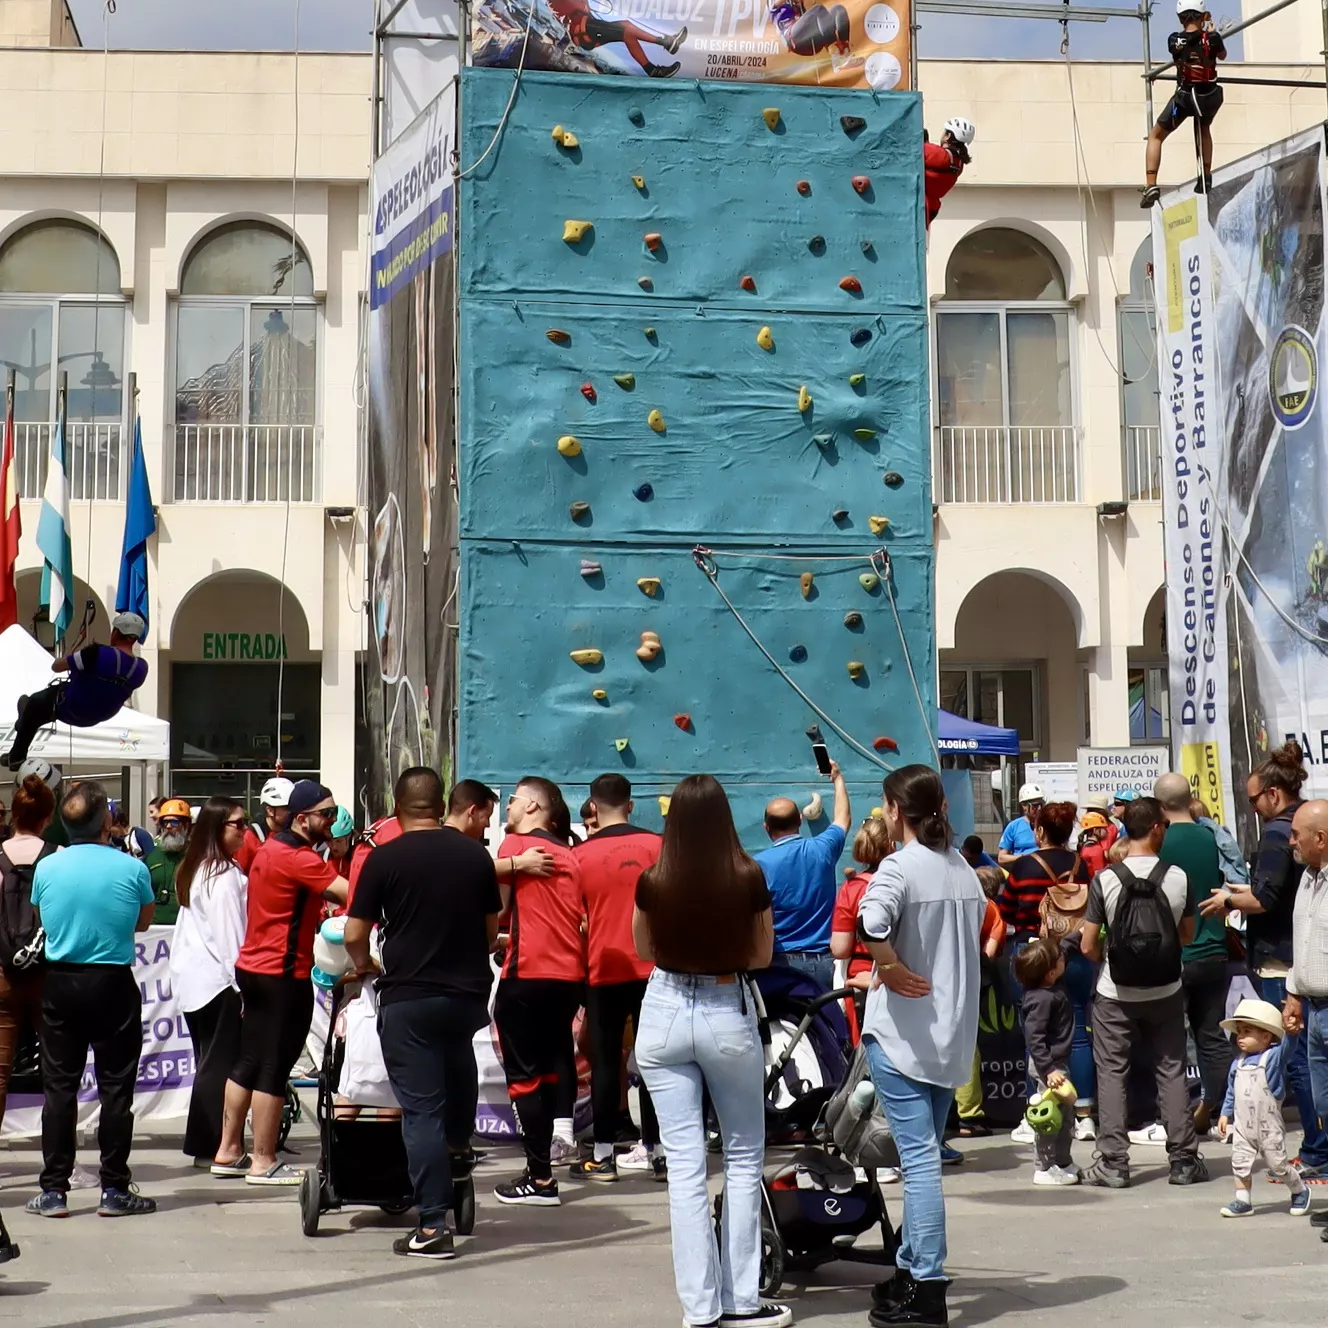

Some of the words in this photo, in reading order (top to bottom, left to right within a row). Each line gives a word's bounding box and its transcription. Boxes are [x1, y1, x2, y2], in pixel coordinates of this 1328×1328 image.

[694, 39, 708, 51] EN
[707, 54, 767, 68] 20/ABRIL/2024
[705, 67, 739, 79] LUCENA
[1188, 254, 1207, 450] Barrancos
[1170, 349, 1191, 529] Deportivo
[1200, 497, 1216, 663] Cañones
[1181, 544, 1197, 725] Descenso
[203, 633, 288, 659] ENTRADA
[1203, 678, 1216, 725] de
[1088, 753, 1160, 766] FEDERACIÓN
[1088, 769, 1143, 779] ANDALUZA
[1146, 769, 1160, 779] DE
[1088, 780, 1154, 793] ESPELEOLOGÍ
